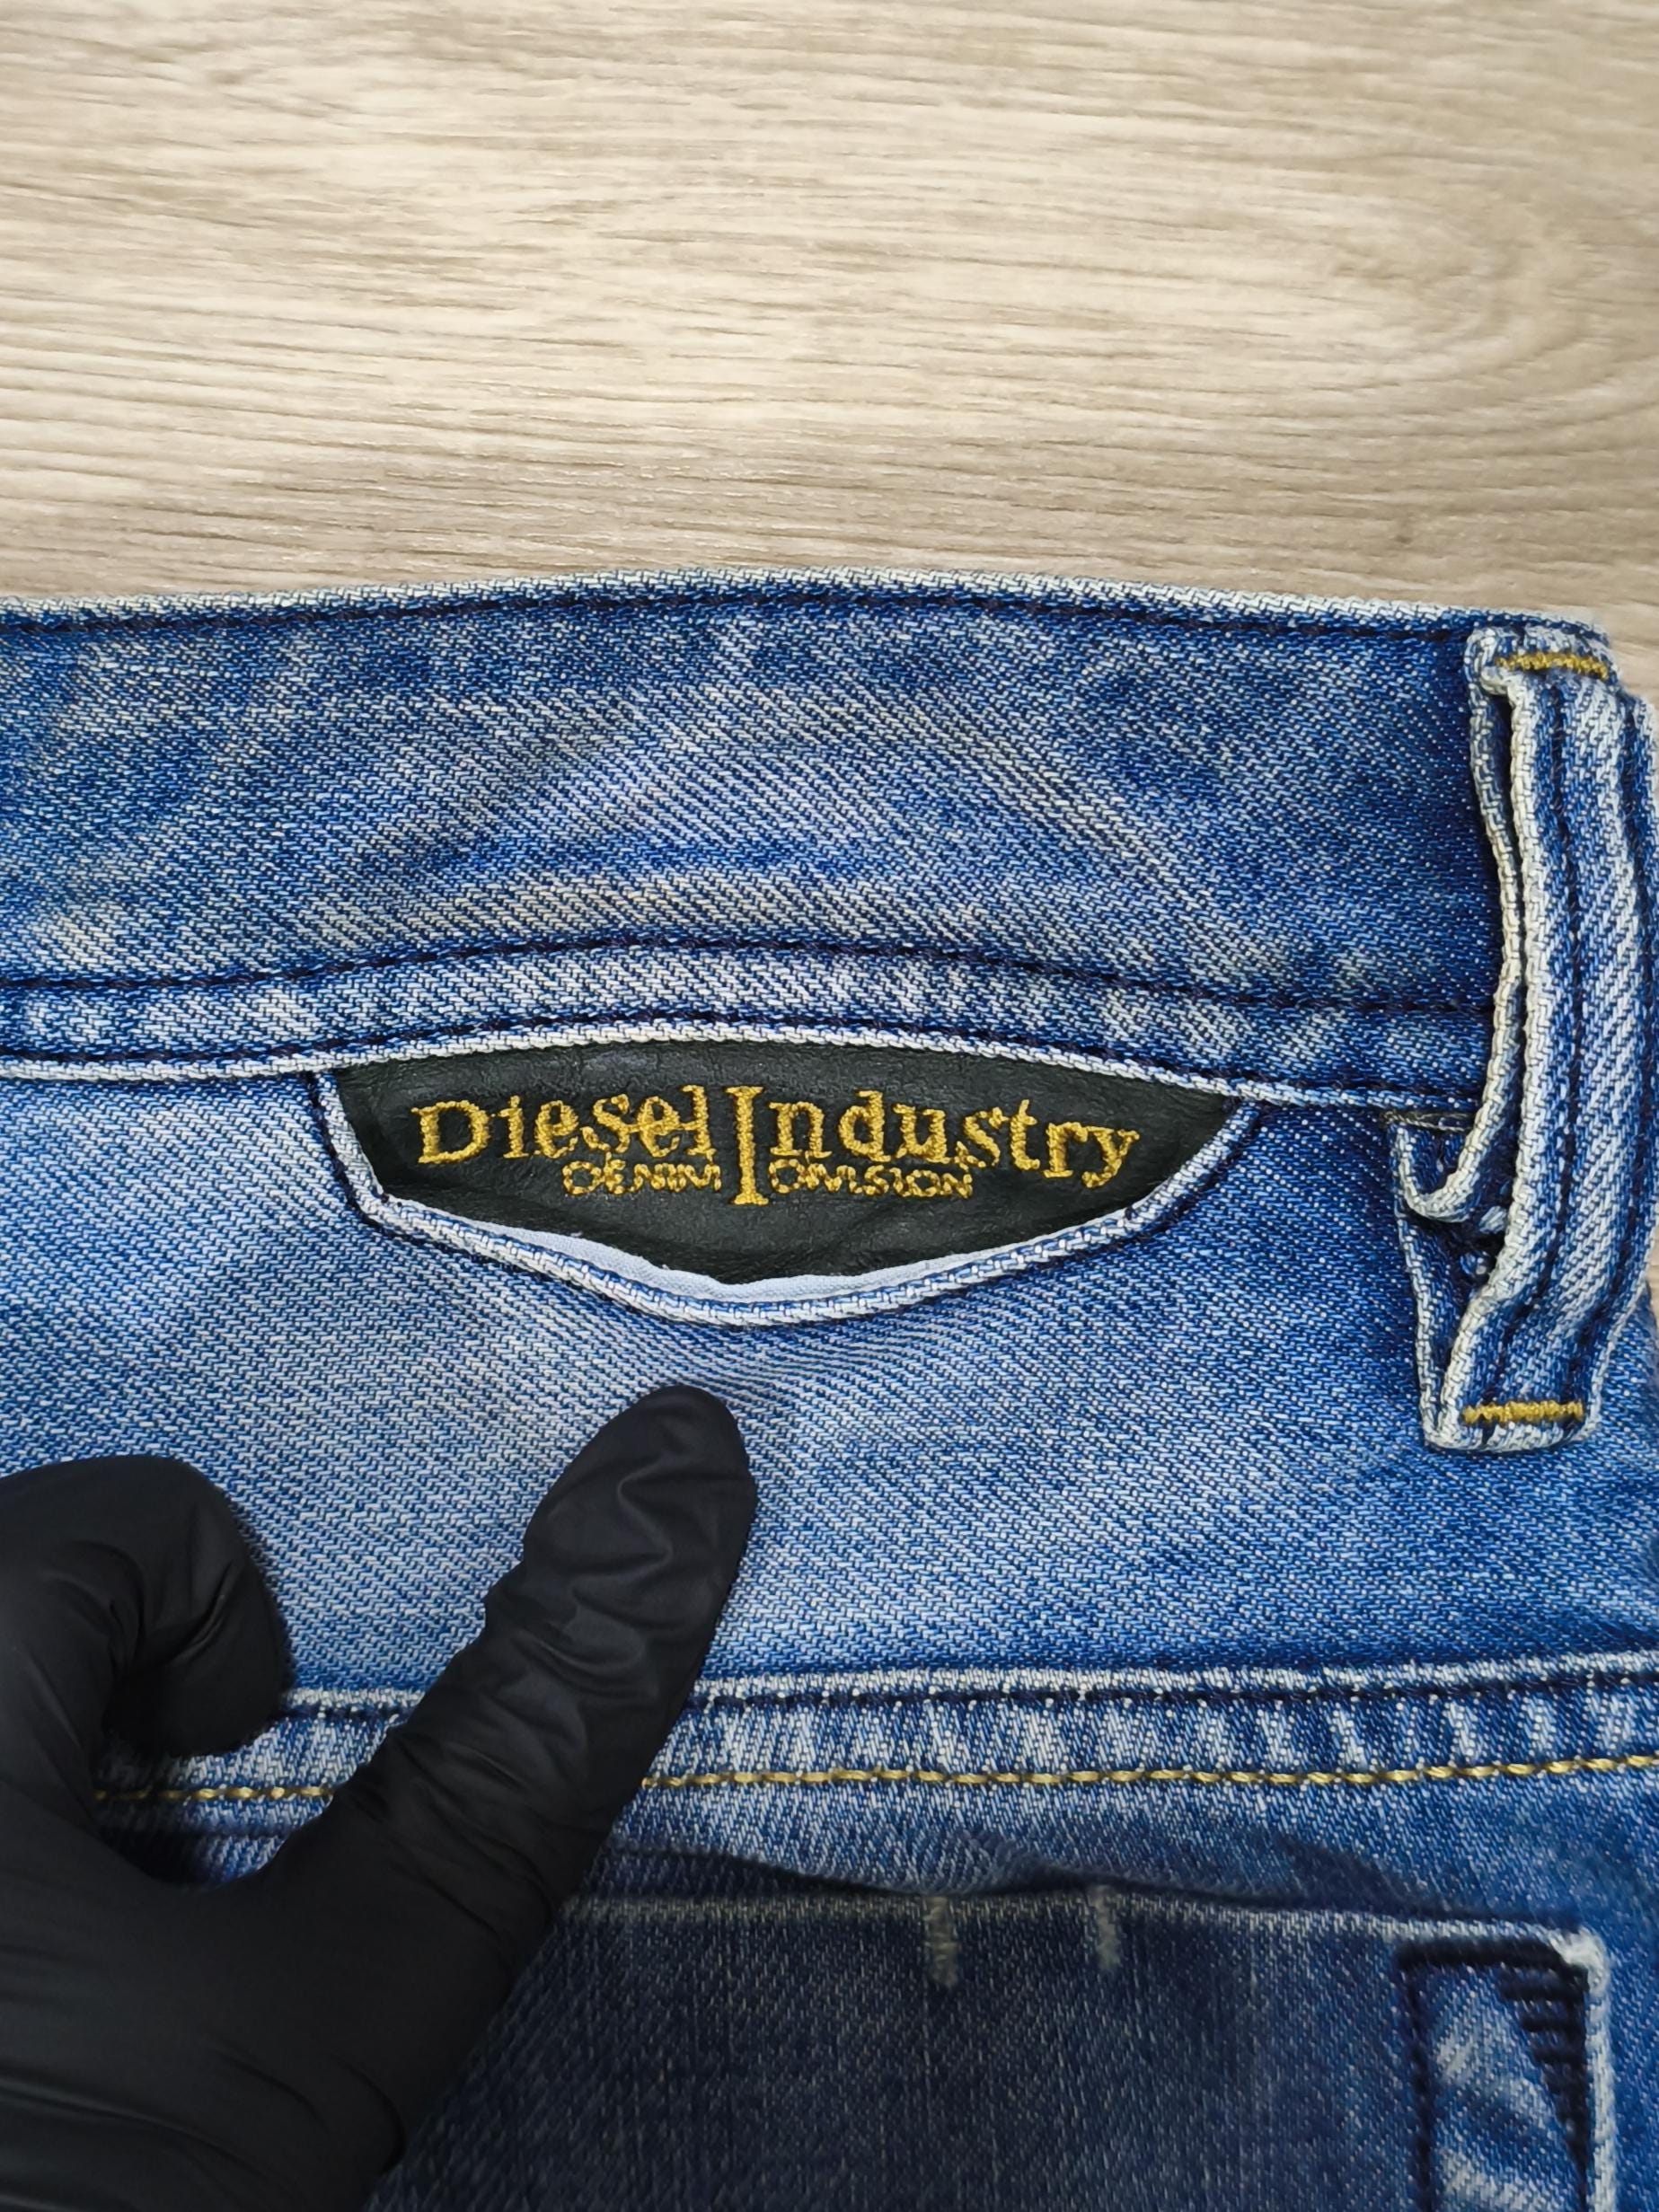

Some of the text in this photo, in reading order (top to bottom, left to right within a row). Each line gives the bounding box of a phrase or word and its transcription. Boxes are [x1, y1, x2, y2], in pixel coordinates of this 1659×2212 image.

[410, 1084, 1140, 1205] Diesel Industry
[561, 1159, 973, 1198] DENIM DIVISION
